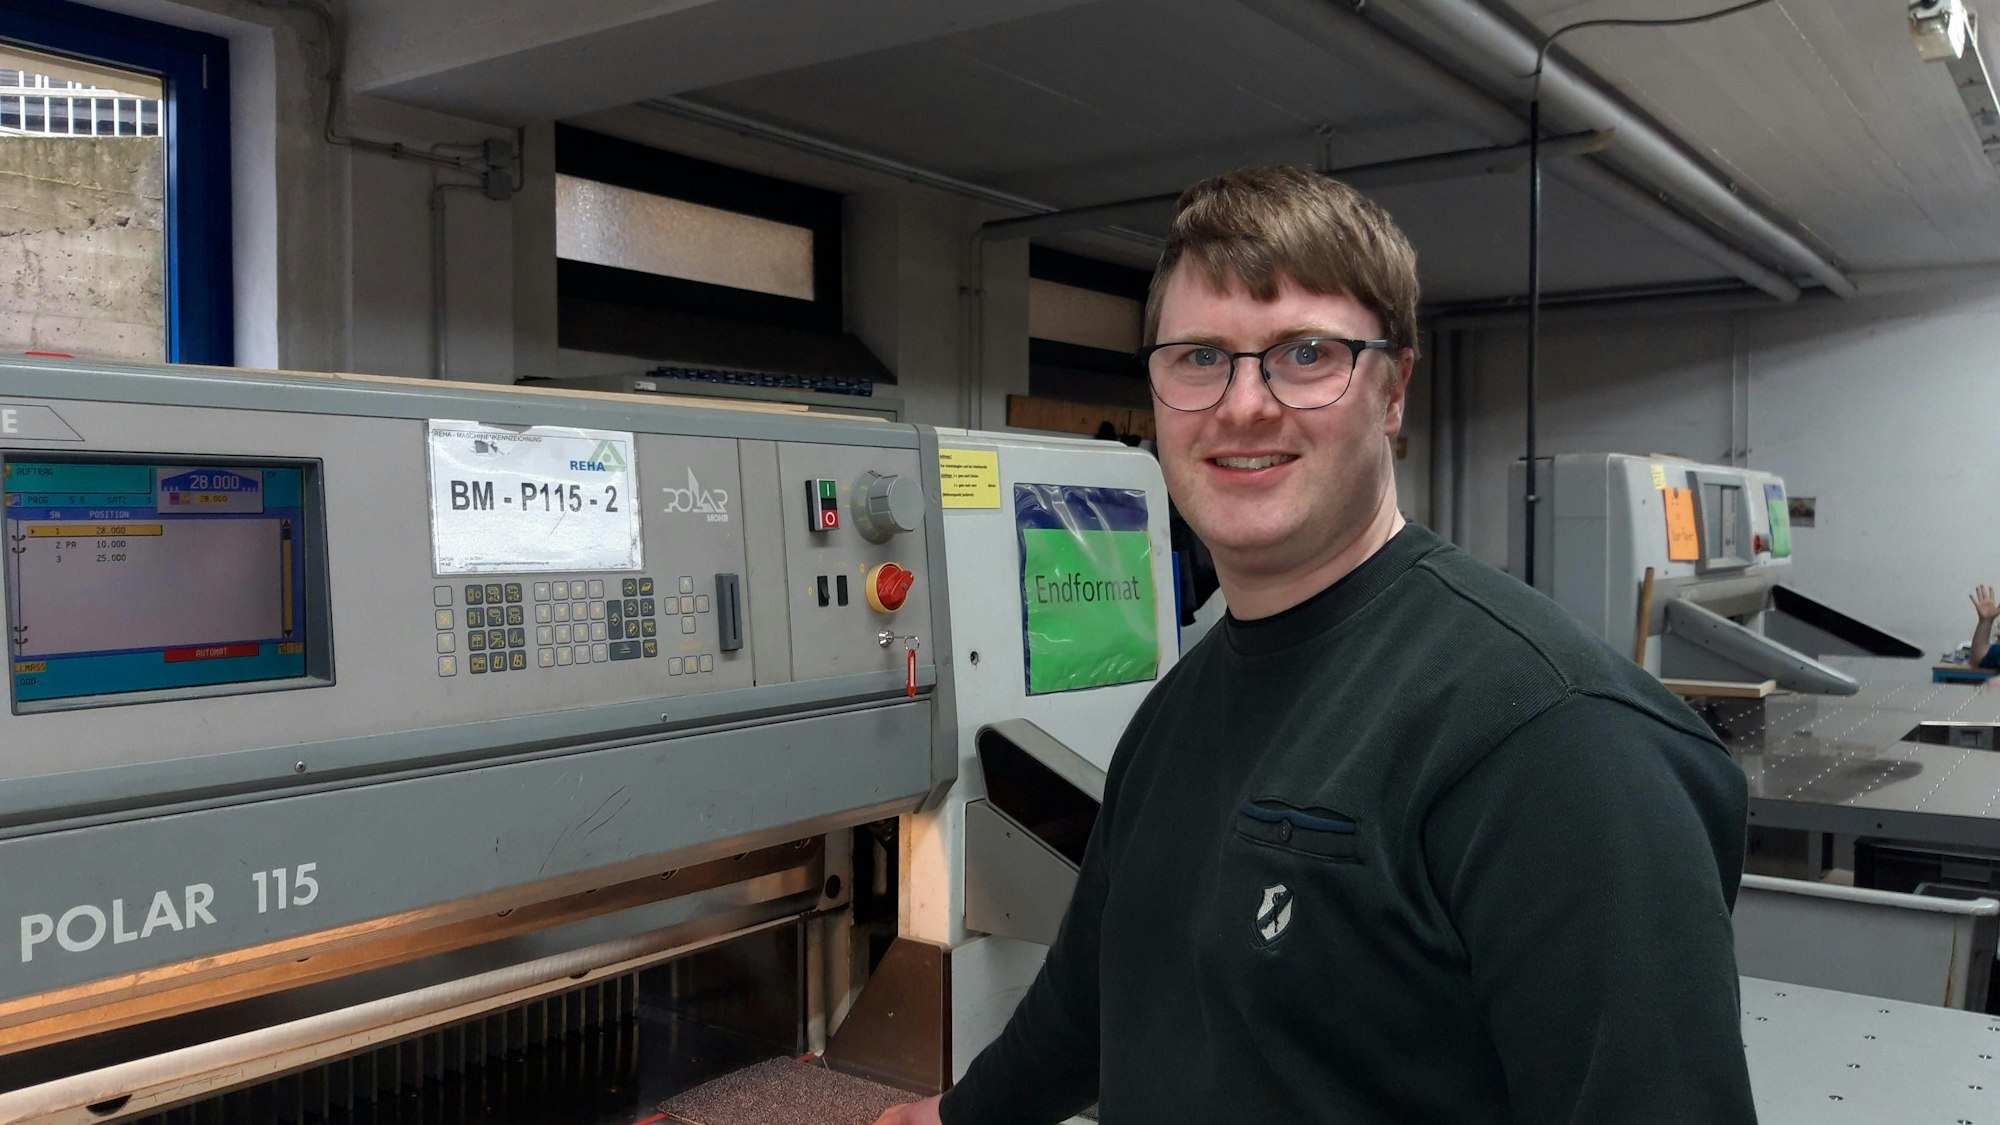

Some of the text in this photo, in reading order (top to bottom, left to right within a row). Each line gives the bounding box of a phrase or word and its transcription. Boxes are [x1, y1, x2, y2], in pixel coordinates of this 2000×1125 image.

[2, 409, 18, 434] E
[433, 430, 452, 438] REHA
[570, 460, 606, 472] REHA
[189, 474, 239, 490] 28.000
[662, 466, 728, 513] POLAR
[451, 480, 495, 511] BM
[521, 482, 582, 513] P115
[605, 485, 618, 513] 2
[89, 511, 129, 519] POSITION
[96, 527, 126, 535] 28.000
[55, 540, 127, 549] 2 PR 10.000
[96, 554, 127, 562] 25.000
[1035, 572, 1140, 604] Endformat
[195, 647, 228, 657] AUTOMAT
[20, 862, 319, 963] POLAR 115
